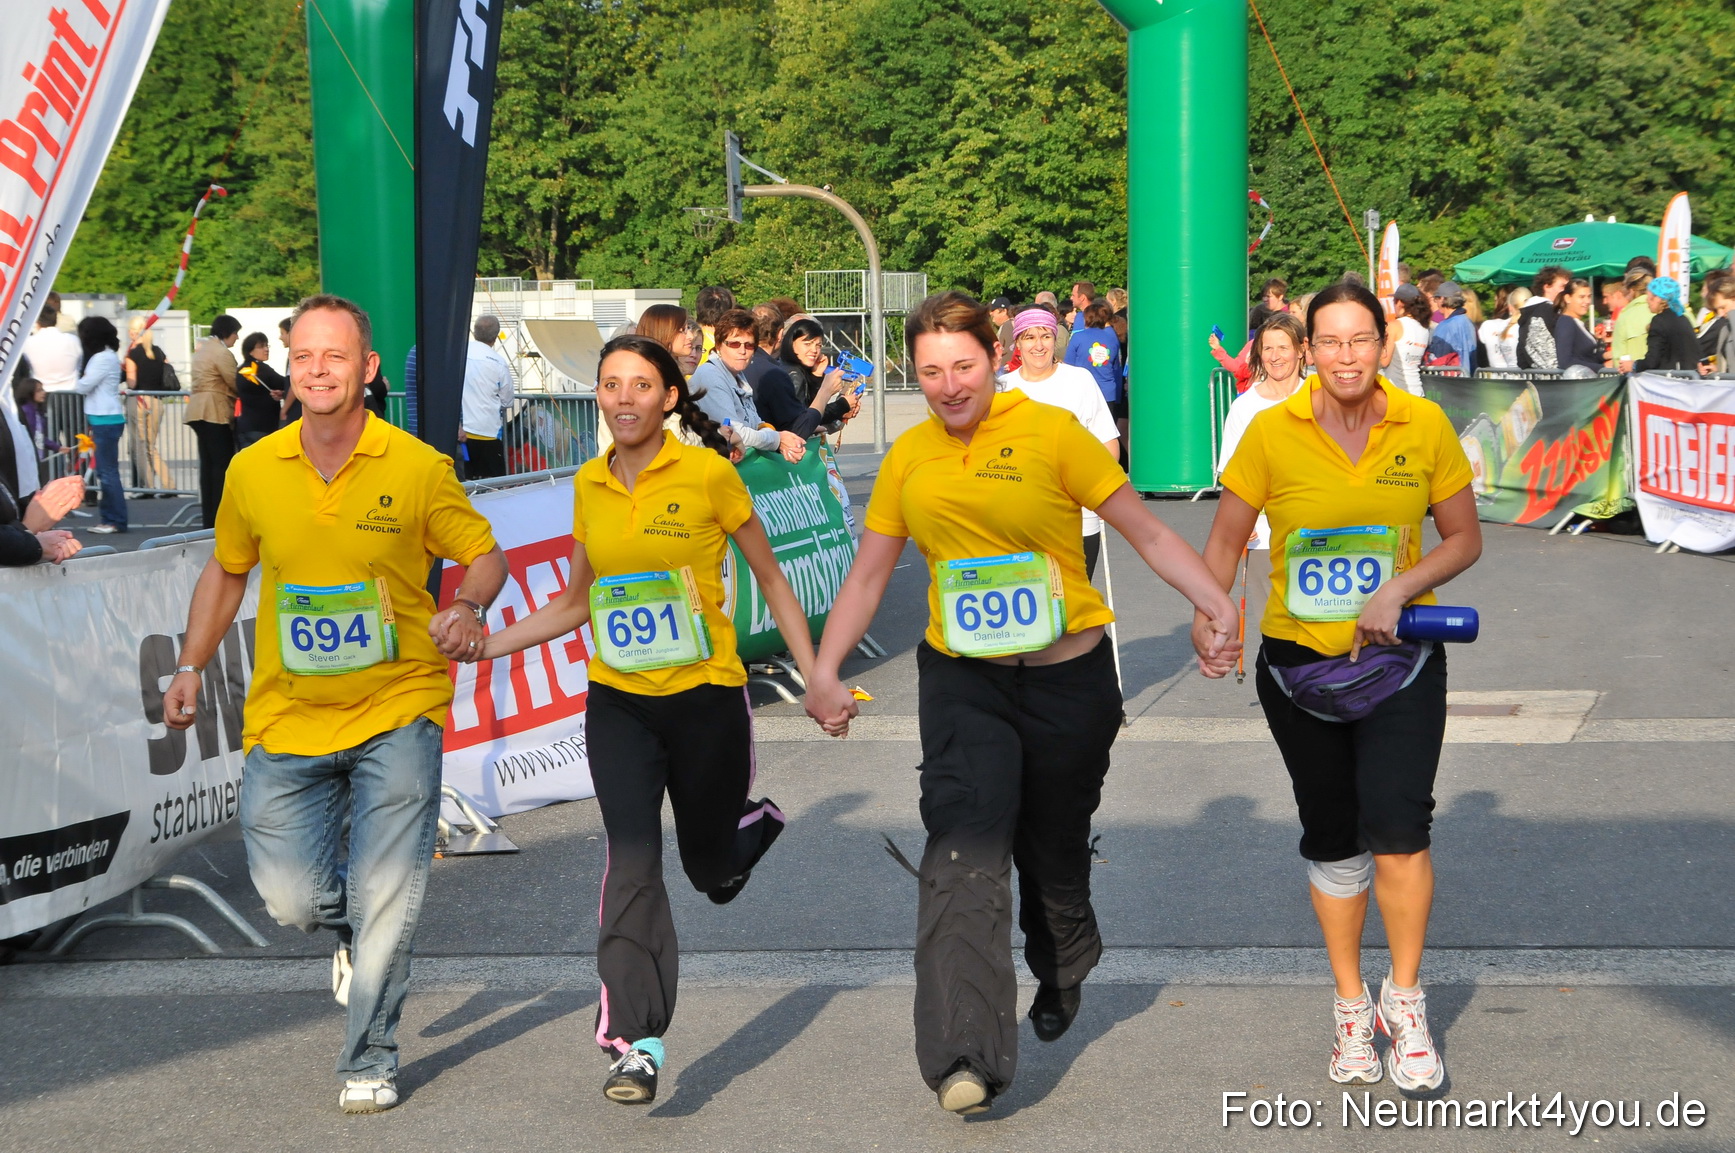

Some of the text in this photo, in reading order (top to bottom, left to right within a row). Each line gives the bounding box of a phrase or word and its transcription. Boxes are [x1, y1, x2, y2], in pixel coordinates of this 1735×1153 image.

[0, 8, 98, 199] Print
[1520, 255, 1591, 264] Lammsbräu
[986, 458, 1017, 471] Casino
[975, 472, 1022, 482] NOVOLINO
[1384, 466, 1414, 478] Casino
[1376, 478, 1420, 488] NOVOLINO
[366, 508, 398, 523] Casino
[653, 514, 685, 528] Casino
[356, 523, 402, 534] NOVOLINO
[643, 528, 690, 539] NOVOLINO
[1298, 557, 1382, 596] 689
[1314, 598, 1352, 607] Martina
[955, 588, 1037, 631] 690
[607, 604, 679, 648] 691
[291, 614, 371, 653] 694
[974, 630, 1010, 641] Daniela
[308, 653, 340, 662] Steven
[618, 646, 653, 659] Carmen
[493, 722, 588, 787] www.me
[150, 766, 246, 844] stadtwer
[13, 854, 42, 880] die
[46, 838, 110, 874] verbinden
